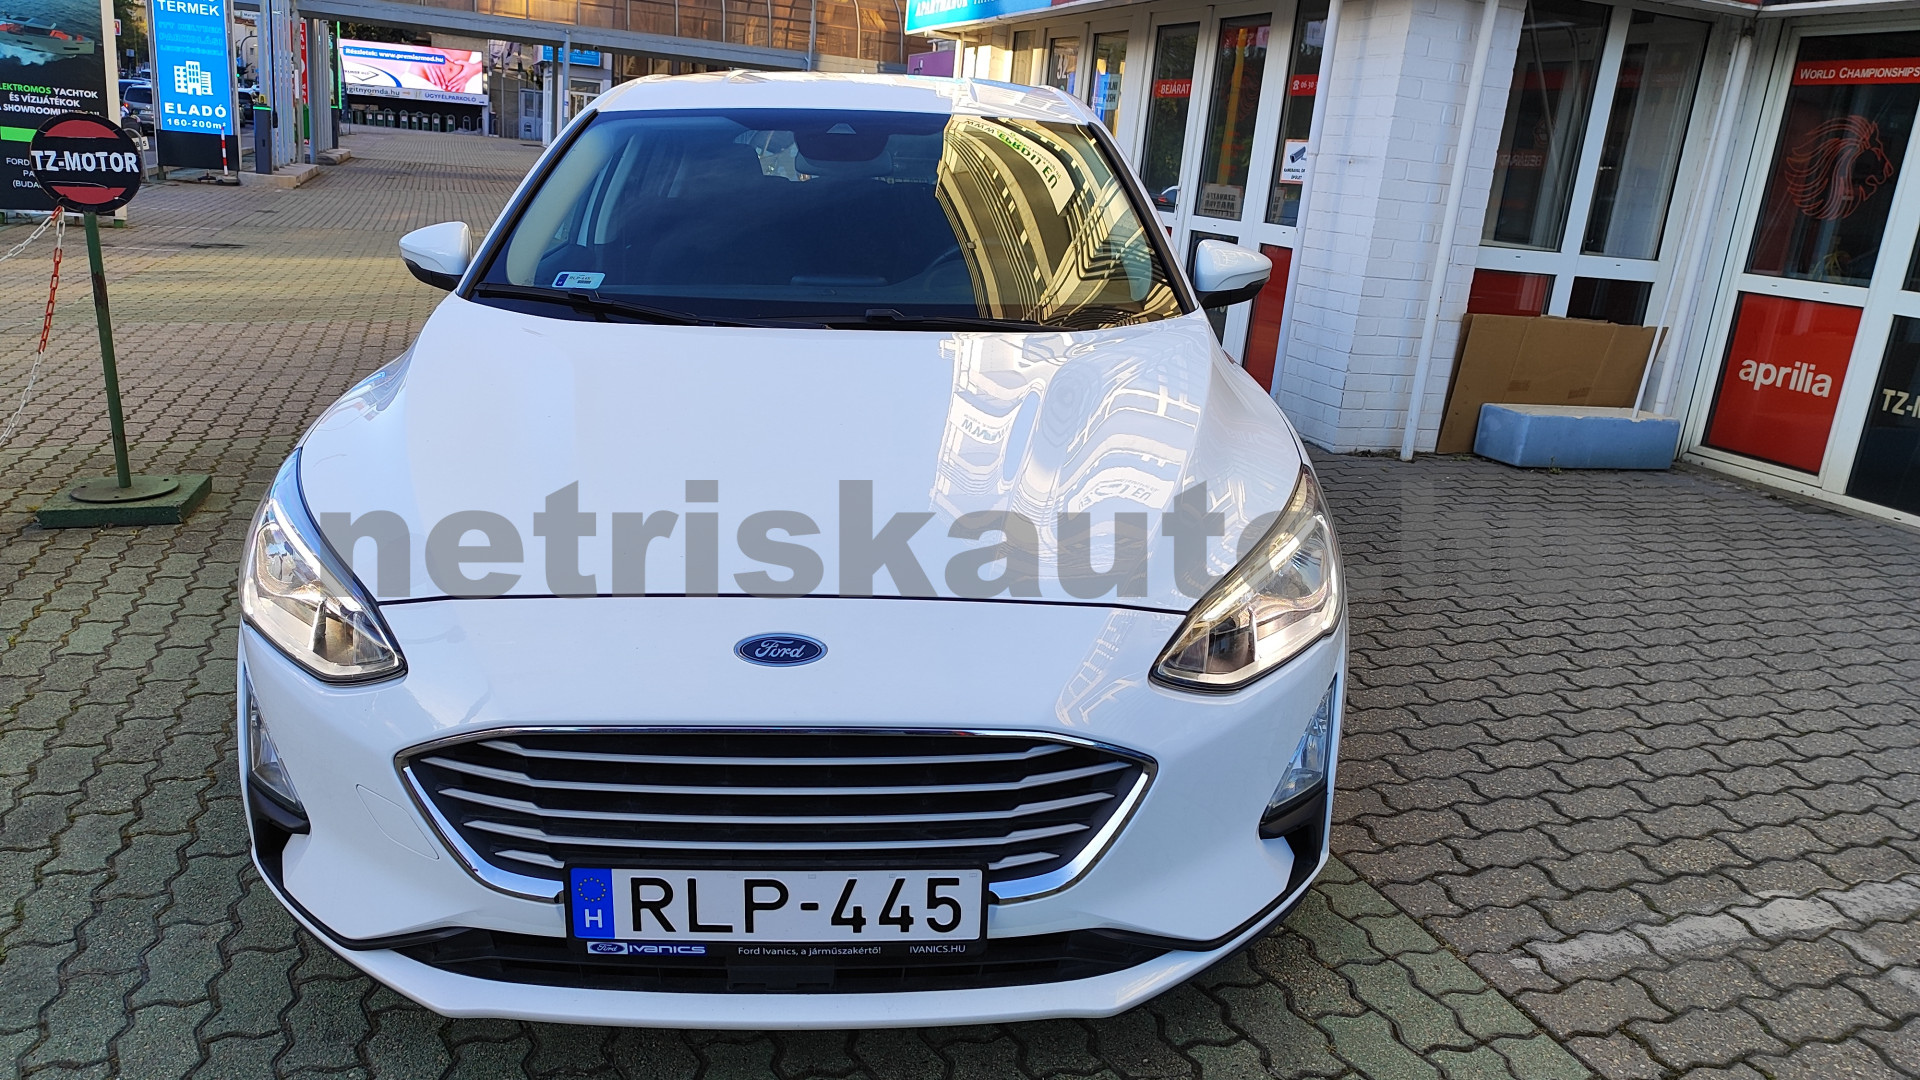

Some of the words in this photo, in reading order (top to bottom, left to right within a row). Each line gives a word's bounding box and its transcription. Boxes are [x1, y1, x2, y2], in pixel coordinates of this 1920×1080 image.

[159, 0, 220, 17] TERMEK
[53, 87, 98, 99] YACHTOK
[1161, 81, 1190, 95] BEJÁRAT
[9, 91, 20, 102] ÉS
[21, 93, 80, 107] VÍZIJÁTÉKOK
[164, 102, 227, 118] ELADÓ
[6, 158, 30, 166] FORD
[31, 150, 139, 173] TZ-MOTOR
[1738, 359, 1833, 398] aprilia
[755, 639, 806, 658] Ford
[630, 876, 962, 934] RLP-445
[584, 908, 603, 928] H
[738, 947, 760, 956] Ford
[762, 947, 799, 957] Ivanics,
[808, 946, 881, 957] járműszakértő!
[909, 945, 966, 954] IVANICS.HU
